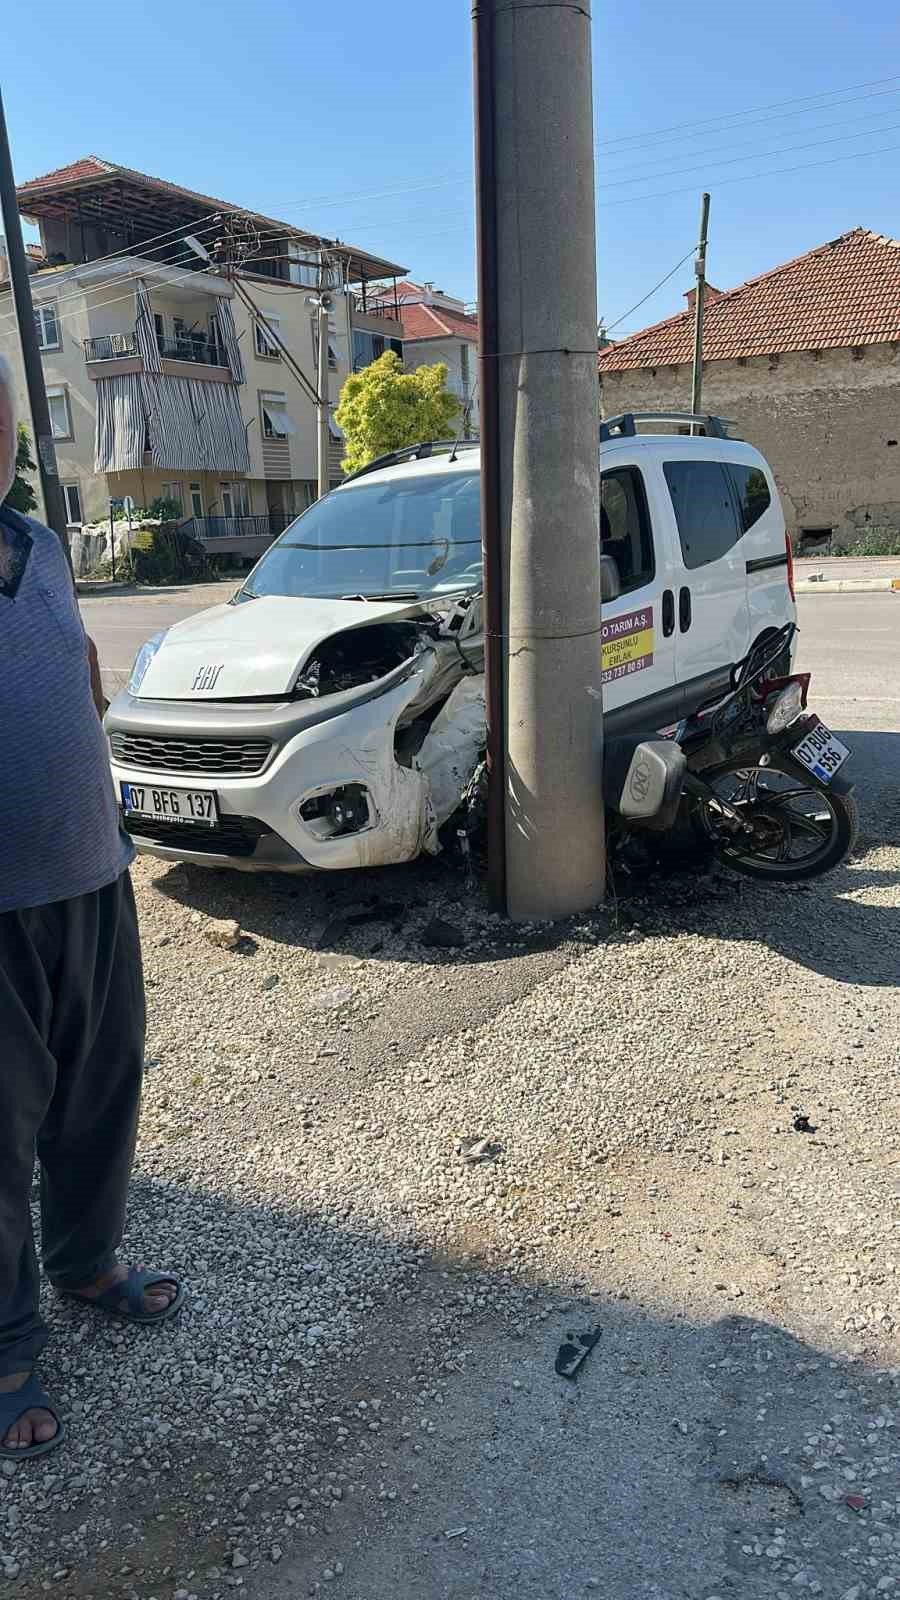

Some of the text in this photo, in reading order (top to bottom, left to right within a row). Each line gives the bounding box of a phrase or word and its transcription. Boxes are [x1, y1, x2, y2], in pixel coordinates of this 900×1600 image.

[610, 618, 633, 633] TARIM
[602, 635, 639, 656] KURŞUNLU
[609, 651, 633, 665] EMLAK
[191, 664, 225, 690] FIAT
[806, 726, 831, 751] BUG
[797, 743, 816, 763] 07
[818, 747, 842, 771] 556
[130, 788, 213, 818] 07 BFG 137
